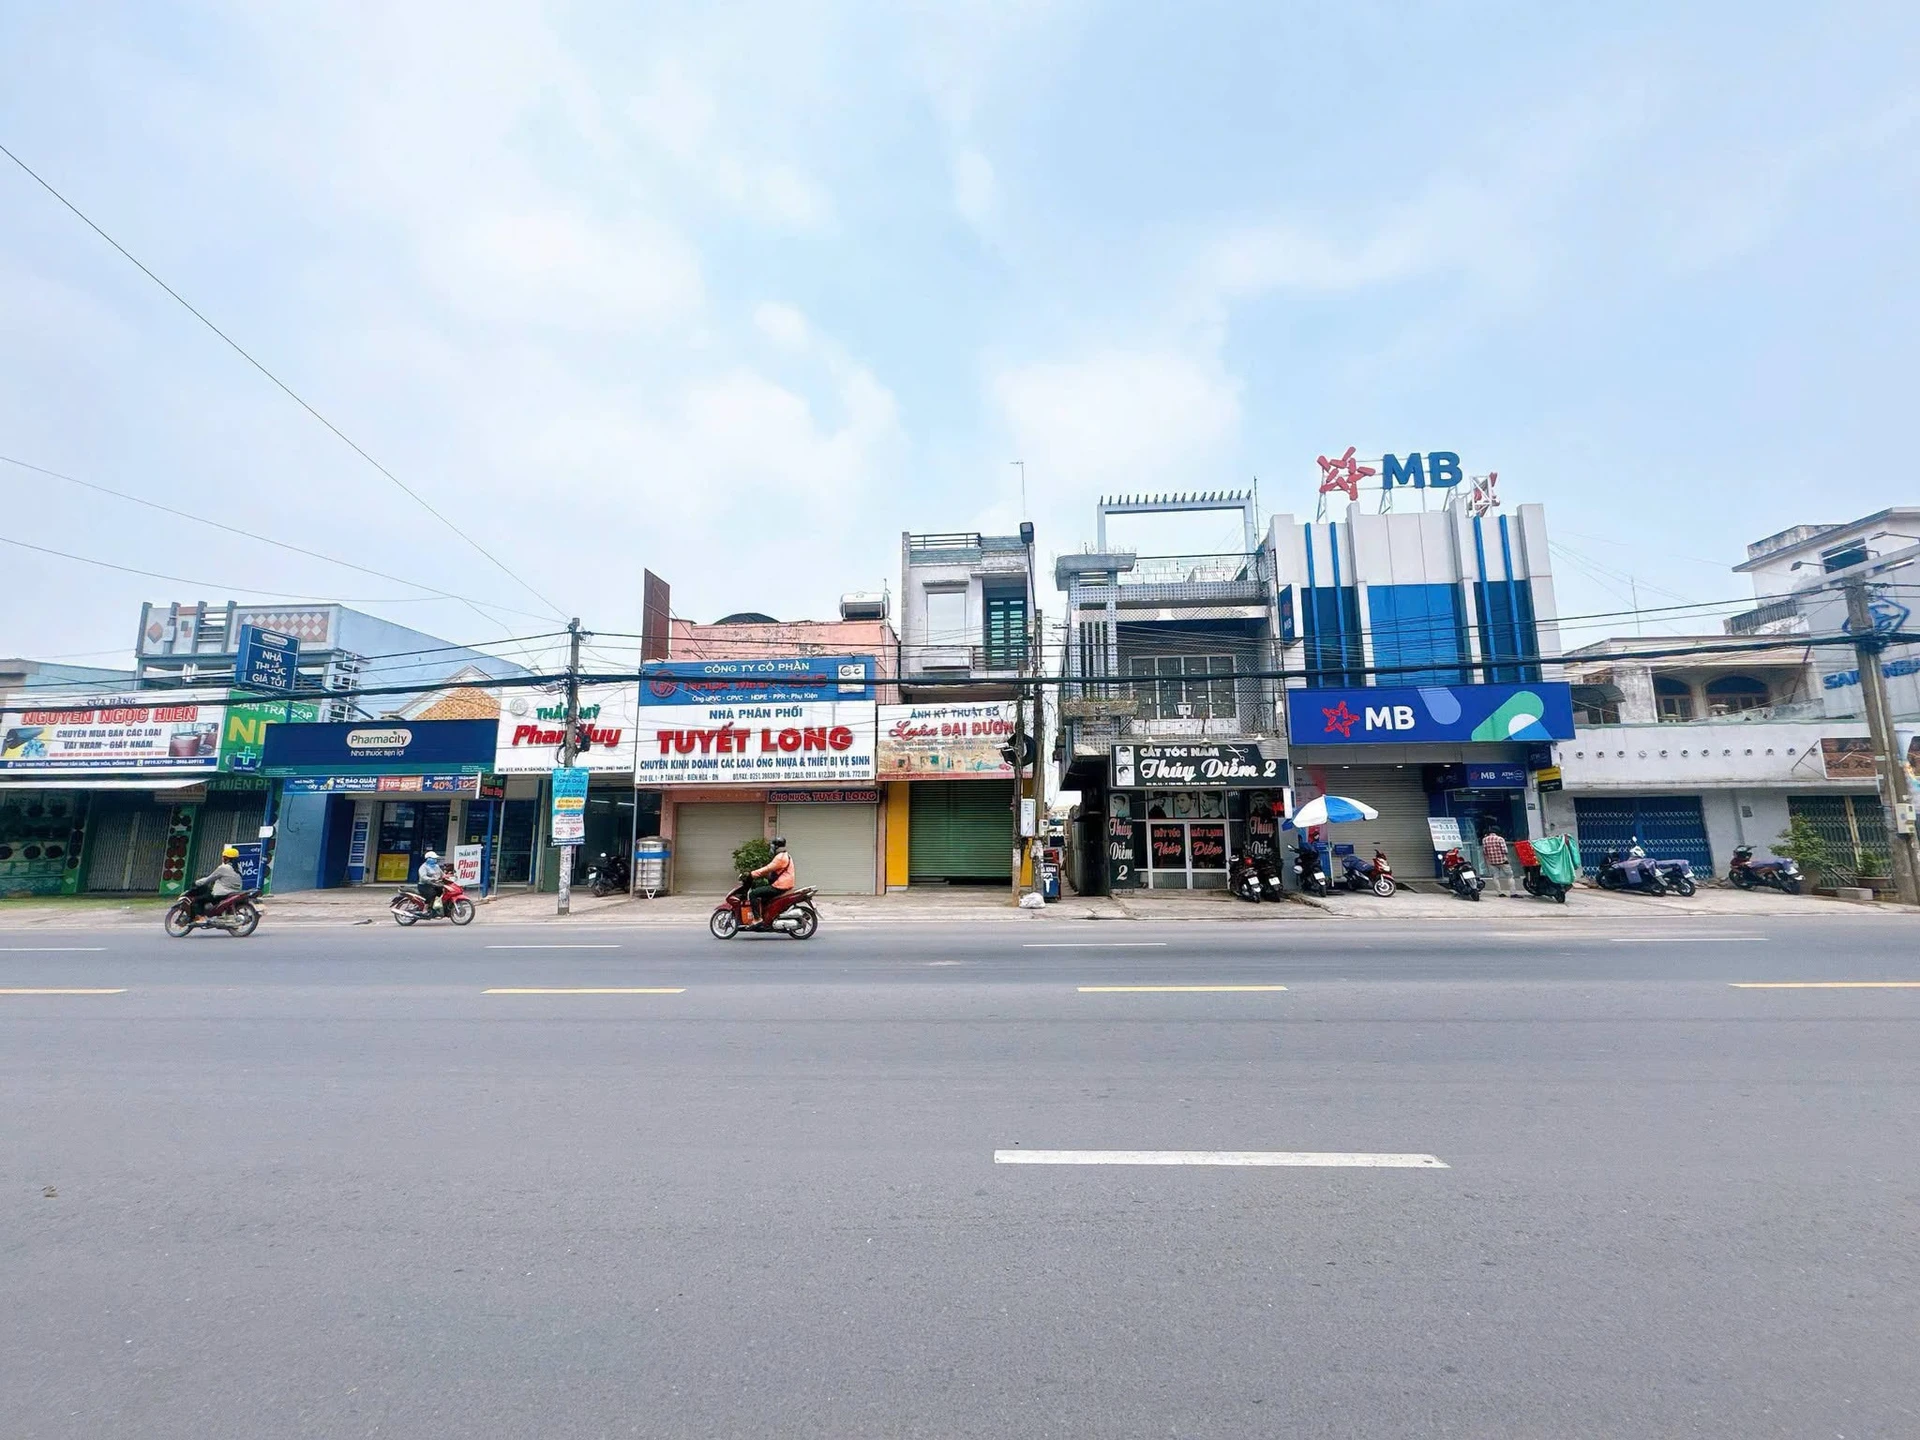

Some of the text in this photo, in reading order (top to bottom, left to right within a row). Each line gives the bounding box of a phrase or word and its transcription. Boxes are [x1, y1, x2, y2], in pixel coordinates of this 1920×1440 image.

[1383, 451, 1463, 490] MB
[262, 650, 283, 663] NHÀ
[255, 660, 287, 676] THUỐC
[704, 664, 737, 674] CÔNG
[741, 664, 755, 673] TY
[778, 659, 810, 671] PHẦN
[98, 707, 149, 727] NGỌC
[709, 705, 803, 720] NHÀ PHÂN PHỐI
[951, 706, 982, 719] THUẬT
[1365, 705, 1416, 731] MB
[89, 729, 106, 738] MUA
[657, 721, 854, 755] TUYẾT LONG
[941, 722, 967, 739] ĐẠI
[351, 732, 407, 746] Pharmacity
[1140, 745, 1219, 757] CẮT TÓC NAM
[640, 757, 669, 770] CHUYÊN
[670, 758, 689, 769] KINH
[691, 758, 718, 769] DOANH
[720, 757, 735, 769] CÁC
[737, 757, 754, 770] LOẠI
[776, 757, 797, 769] NHỰA
[799, 757, 806, 767] &
[807, 754, 828, 767] THIẾT
[830, 756, 838, 768] BỊ
[840, 755, 849, 768] VỆ
[852, 755, 870, 766] SINH
[1140, 757, 1277, 781] Thúy Diễm 2
[1480, 771, 1496, 780] MB
[432, 780, 454, 790] 40%
[812, 789, 843, 801] TUYẾT
[845, 791, 876, 801] LONG
[1109, 818, 1133, 839] Thúy
[1109, 841, 1134, 860] Diễm
[458, 860, 478, 870] Phan
[1116, 864, 1129, 881] 2
[460, 869, 476, 880] Huy
